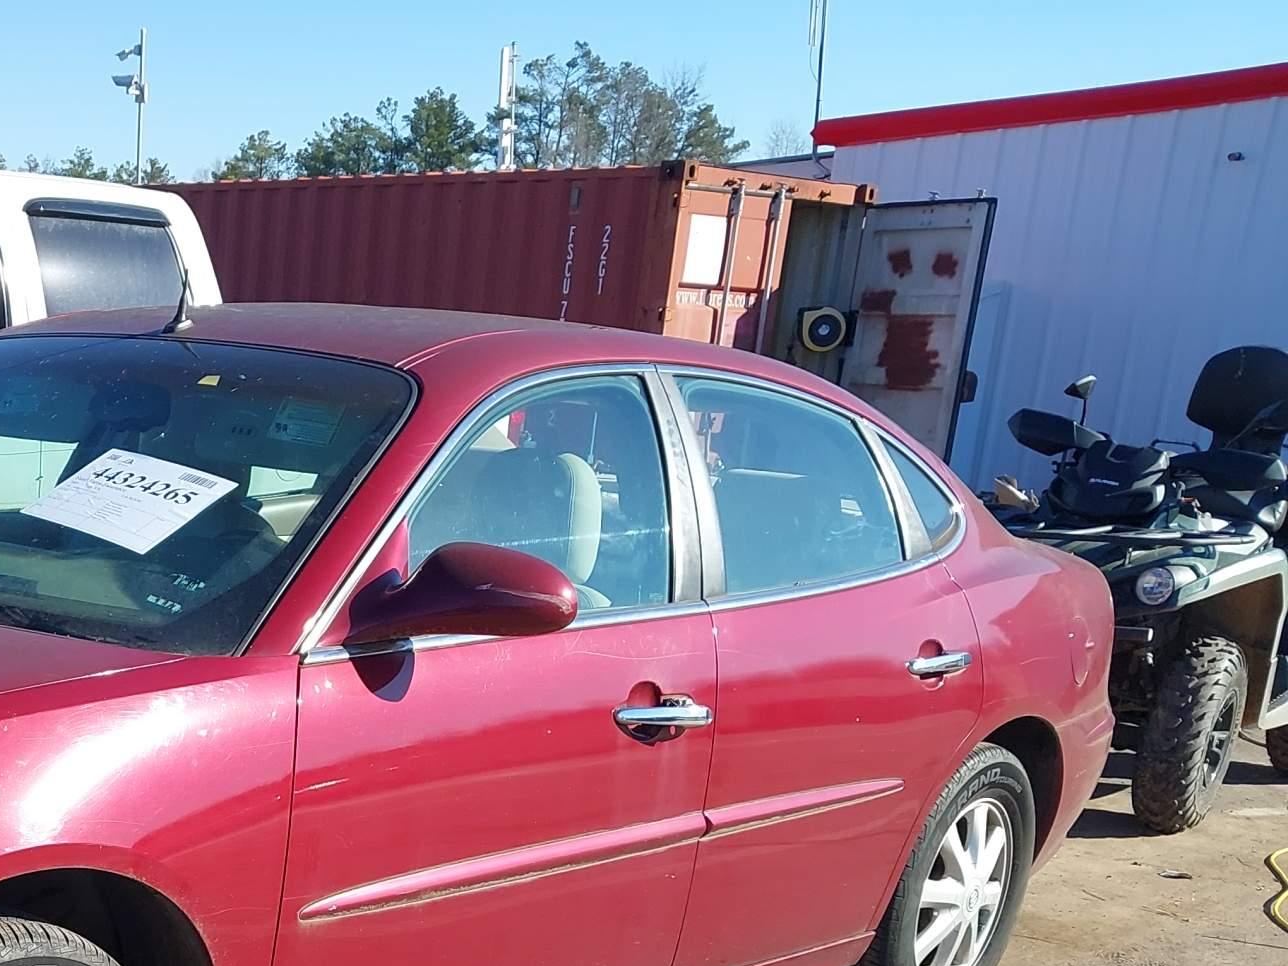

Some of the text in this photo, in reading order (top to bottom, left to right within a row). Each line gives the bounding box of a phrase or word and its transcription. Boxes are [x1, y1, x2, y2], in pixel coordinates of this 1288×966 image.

[562, 225, 577, 295] FSCU
[597, 225, 612, 295] 22G1
[92, 467, 200, 505] 44324265
